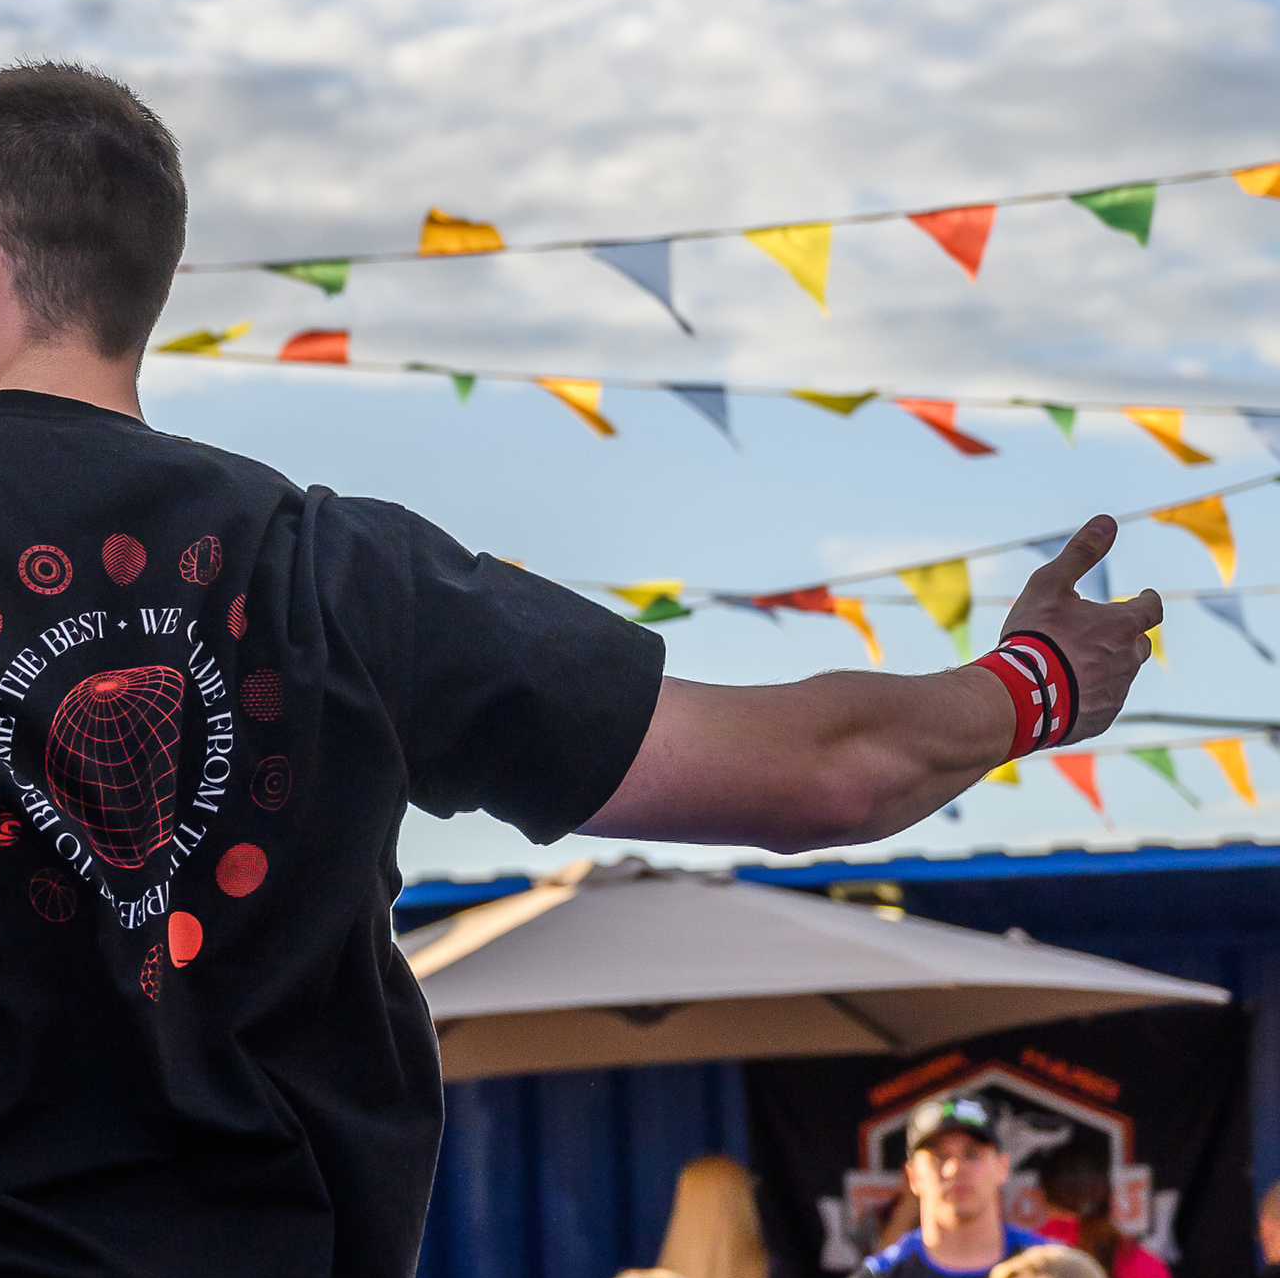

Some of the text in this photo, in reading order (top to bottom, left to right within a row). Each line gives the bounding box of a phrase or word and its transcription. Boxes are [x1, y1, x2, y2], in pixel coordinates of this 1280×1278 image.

[39, 610, 108, 658] BEST
[140, 607, 183, 636] WE
[192, 710, 234, 814] FROM
[55, 831, 93, 882] TO
